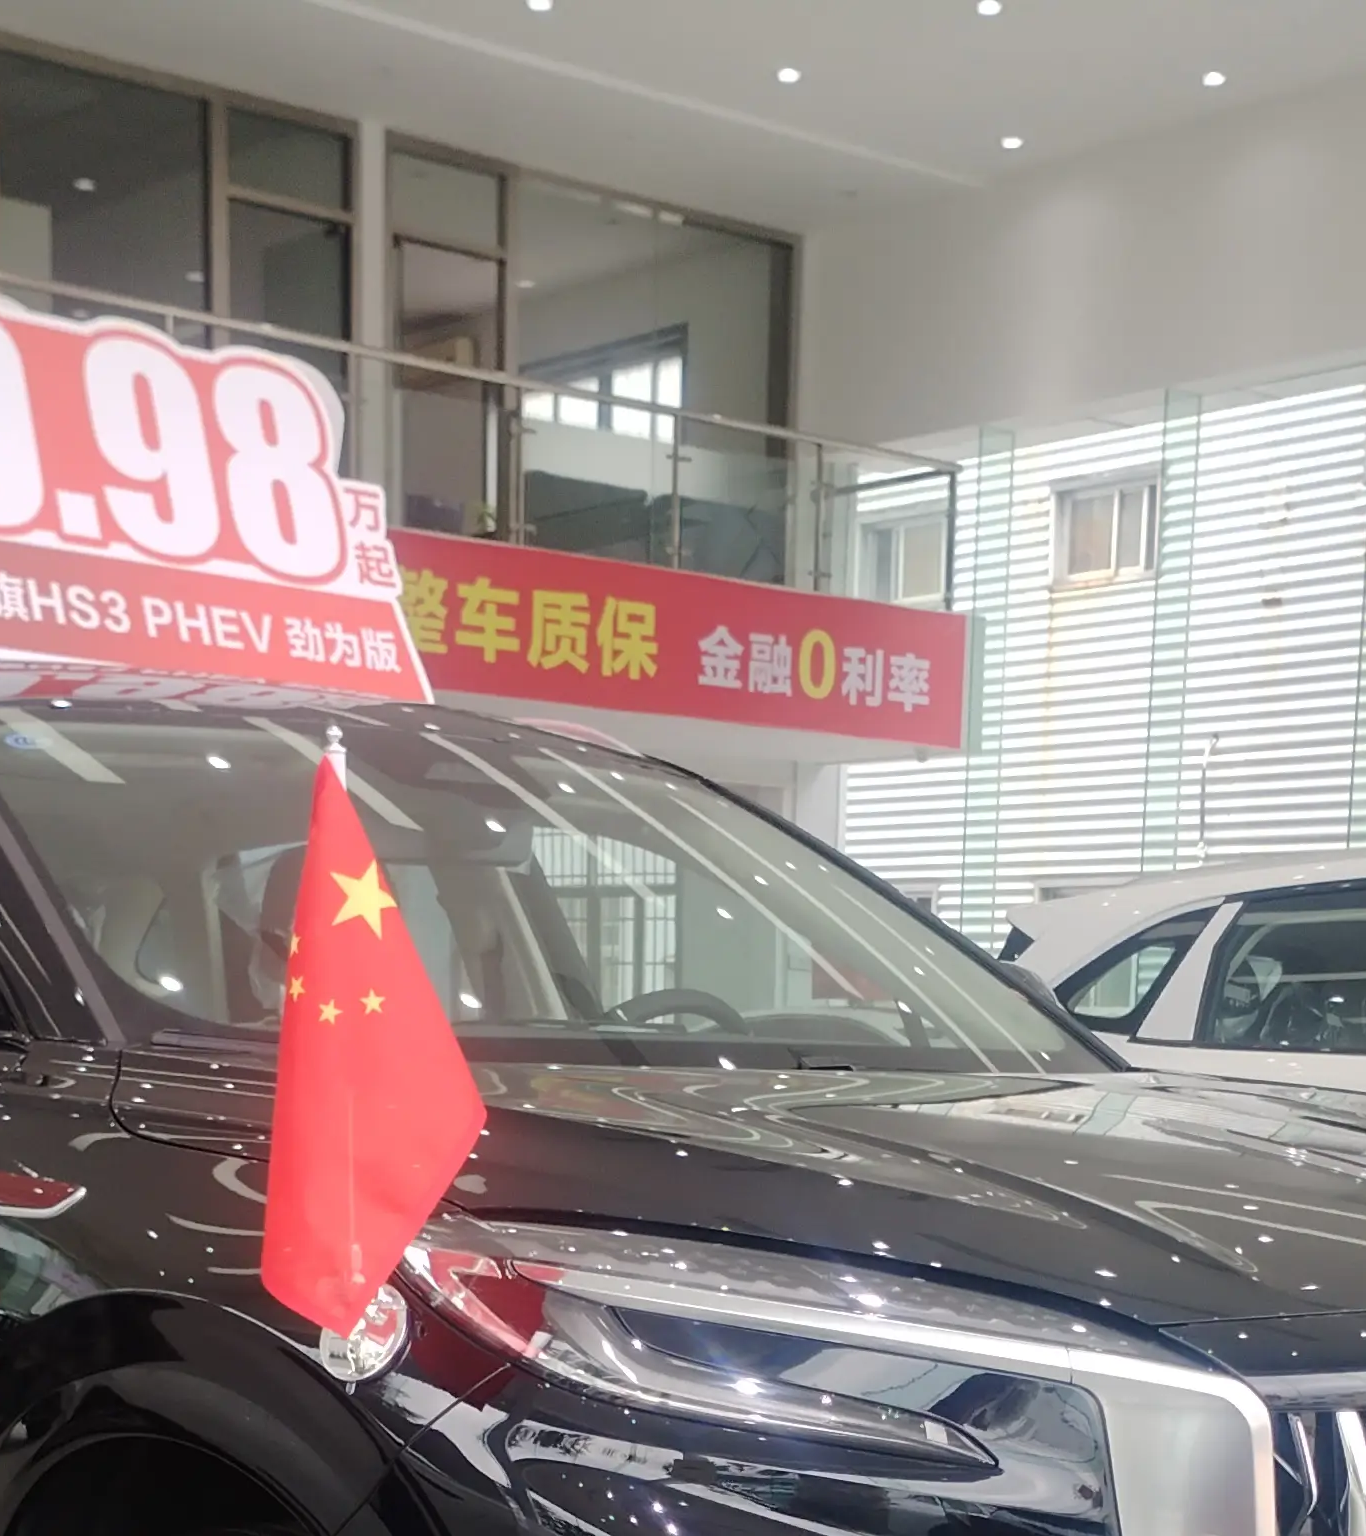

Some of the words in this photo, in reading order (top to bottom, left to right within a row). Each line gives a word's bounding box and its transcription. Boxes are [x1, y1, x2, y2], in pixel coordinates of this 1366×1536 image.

[343, 485, 396, 588] 万起
[142, 596, 273, 654] PHEV
[285, 616, 403, 674] 劲为版
[698, 625, 931, 713] 金融0利率
